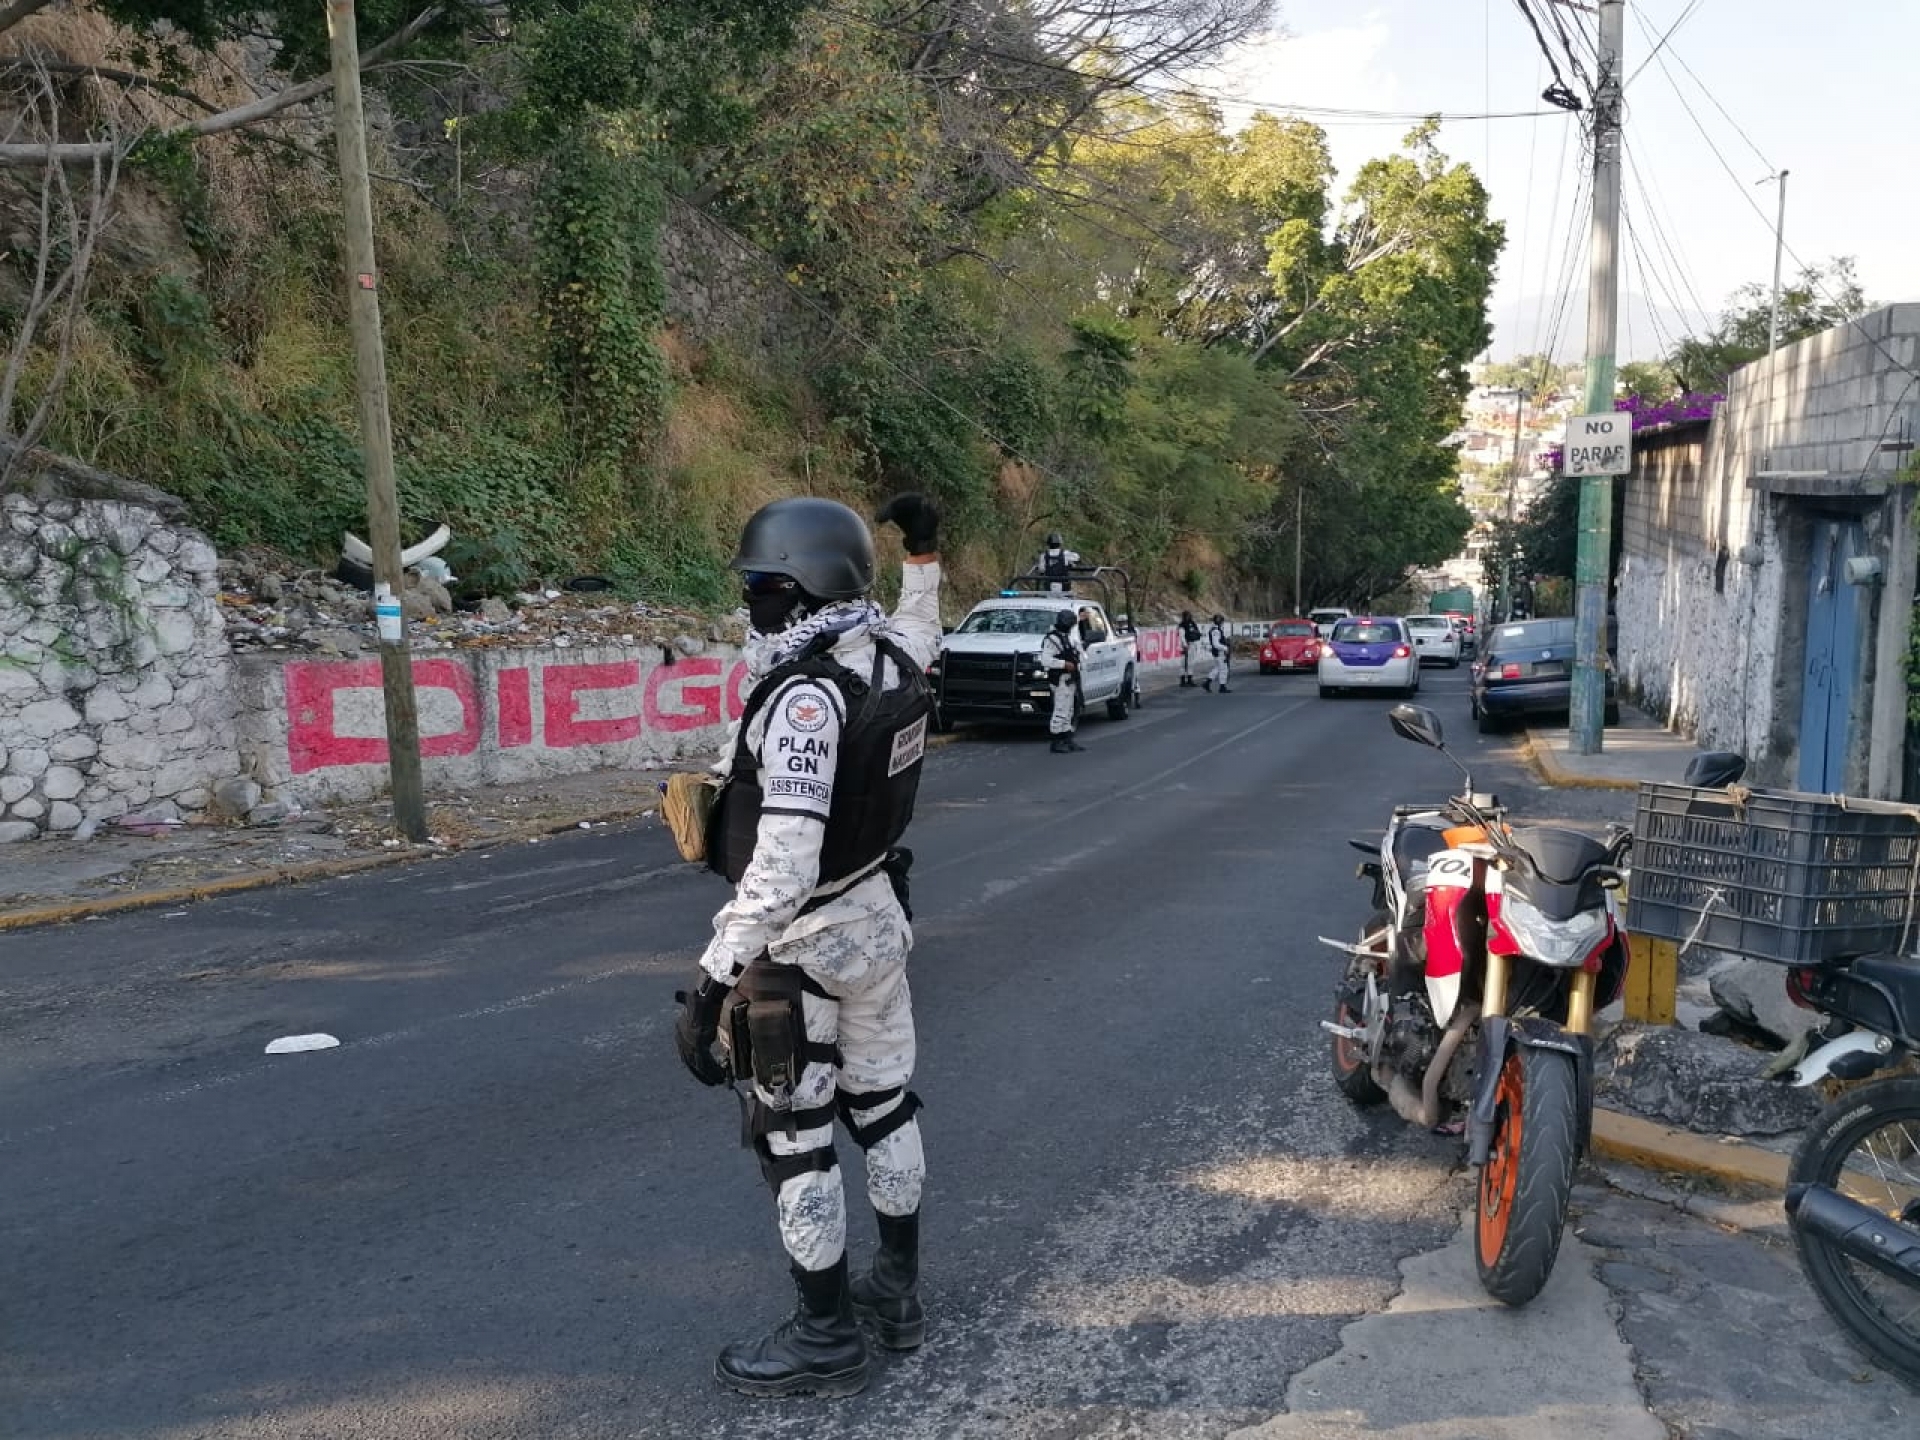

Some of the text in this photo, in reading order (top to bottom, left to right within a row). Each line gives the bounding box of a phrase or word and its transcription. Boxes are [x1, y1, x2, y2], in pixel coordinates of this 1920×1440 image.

[1585, 421, 1613, 434] NO
[779, 736, 829, 760] PLAN
[787, 755, 818, 775] GN
